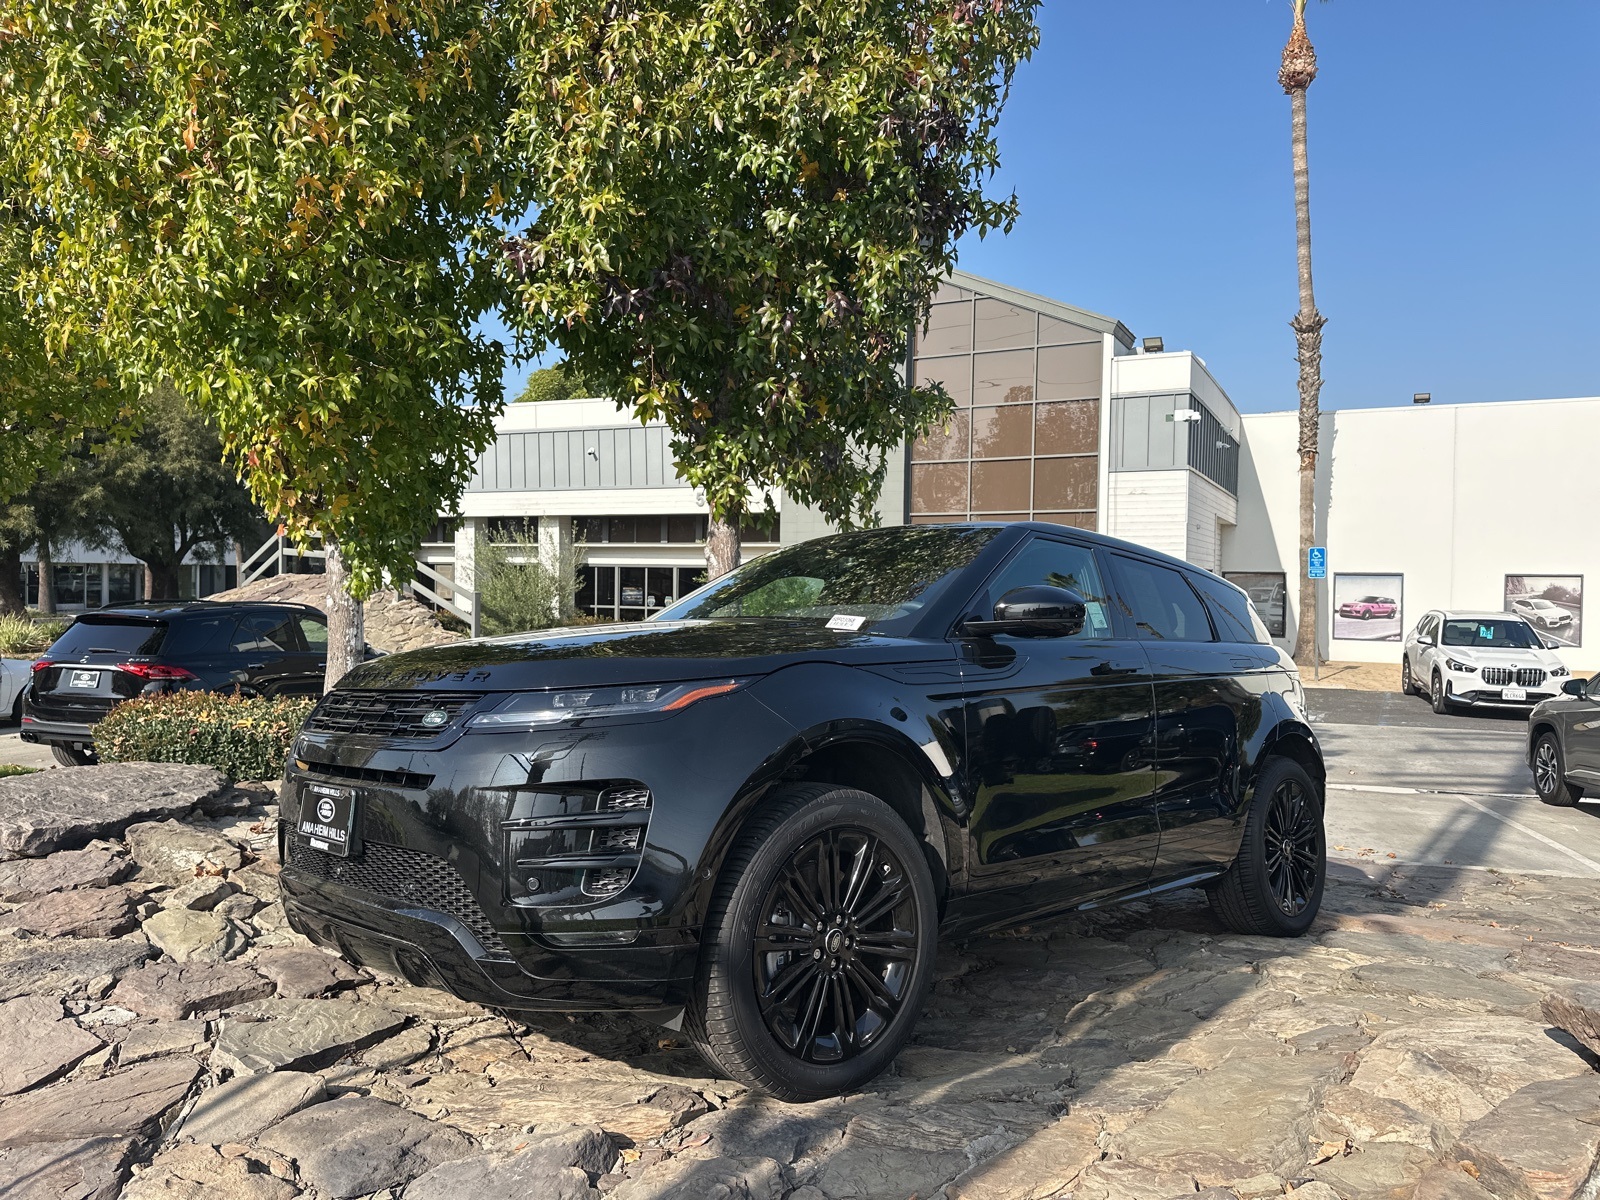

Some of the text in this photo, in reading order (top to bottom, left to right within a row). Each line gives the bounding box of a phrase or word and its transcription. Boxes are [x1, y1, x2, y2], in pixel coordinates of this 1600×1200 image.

[400, 670, 491, 683] ROVER
[302, 821, 346, 841] ANAHEIM HILLS
